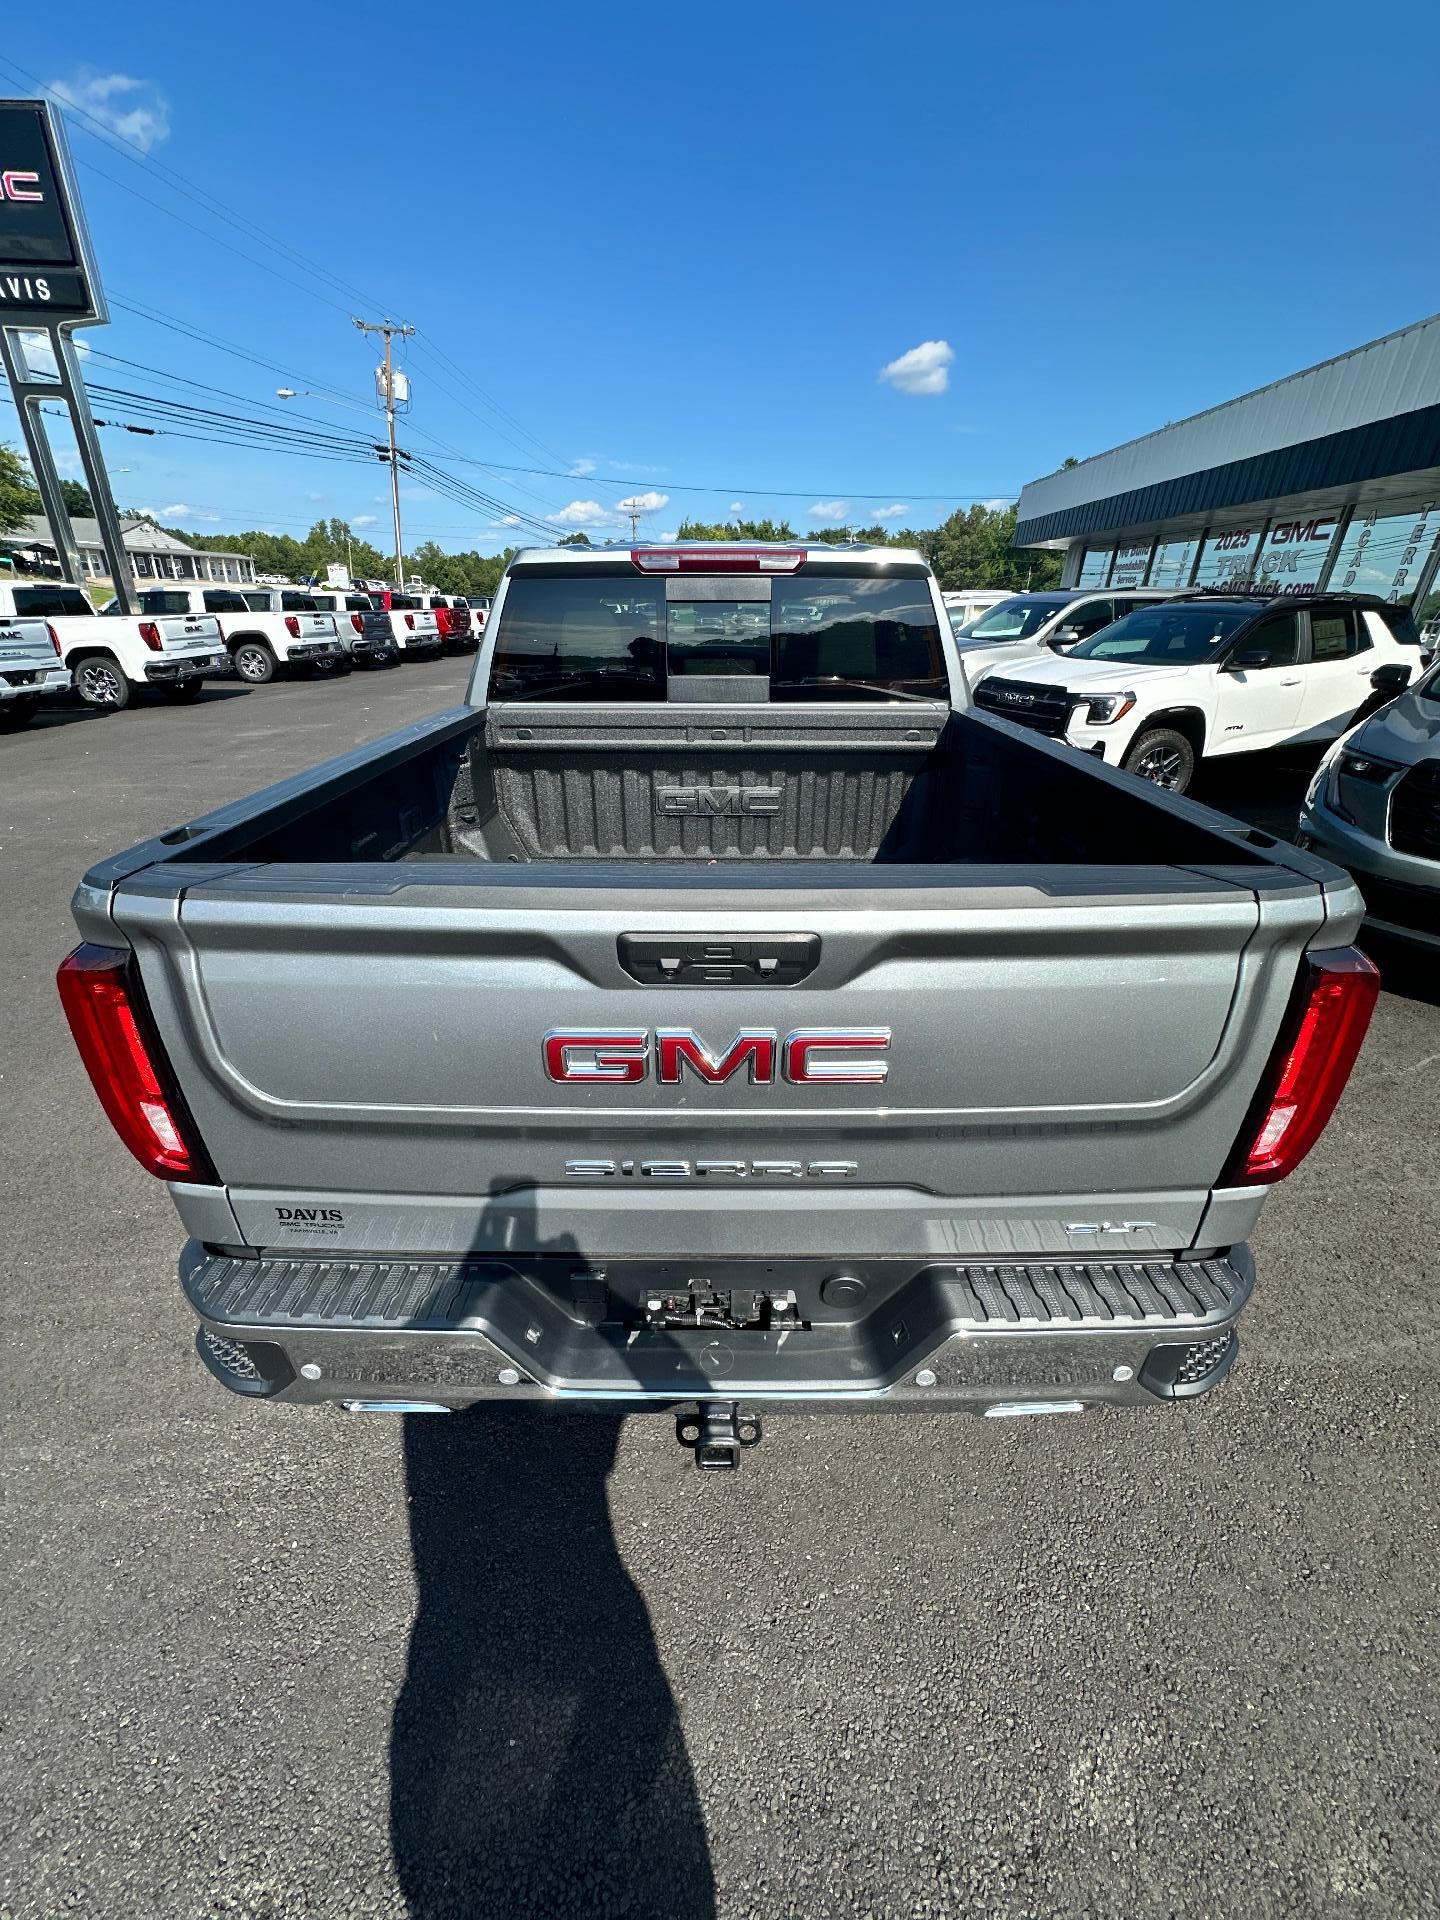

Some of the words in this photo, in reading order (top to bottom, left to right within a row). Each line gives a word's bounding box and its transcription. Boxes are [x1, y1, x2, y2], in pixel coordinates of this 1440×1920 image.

[0, 171, 43, 201] C
[1214, 528, 1251, 551] 2025
[1270, 516, 1336, 545] GMC
[1217, 549, 1304, 577] TRUCK
[657, 786, 782, 815] GMC
[542, 1026, 892, 1085] GMC
[564, 1160, 860, 1178] SIERRA
[275, 1207, 343, 1222] DAVIS
[1065, 1221, 1157, 1234] SLT
